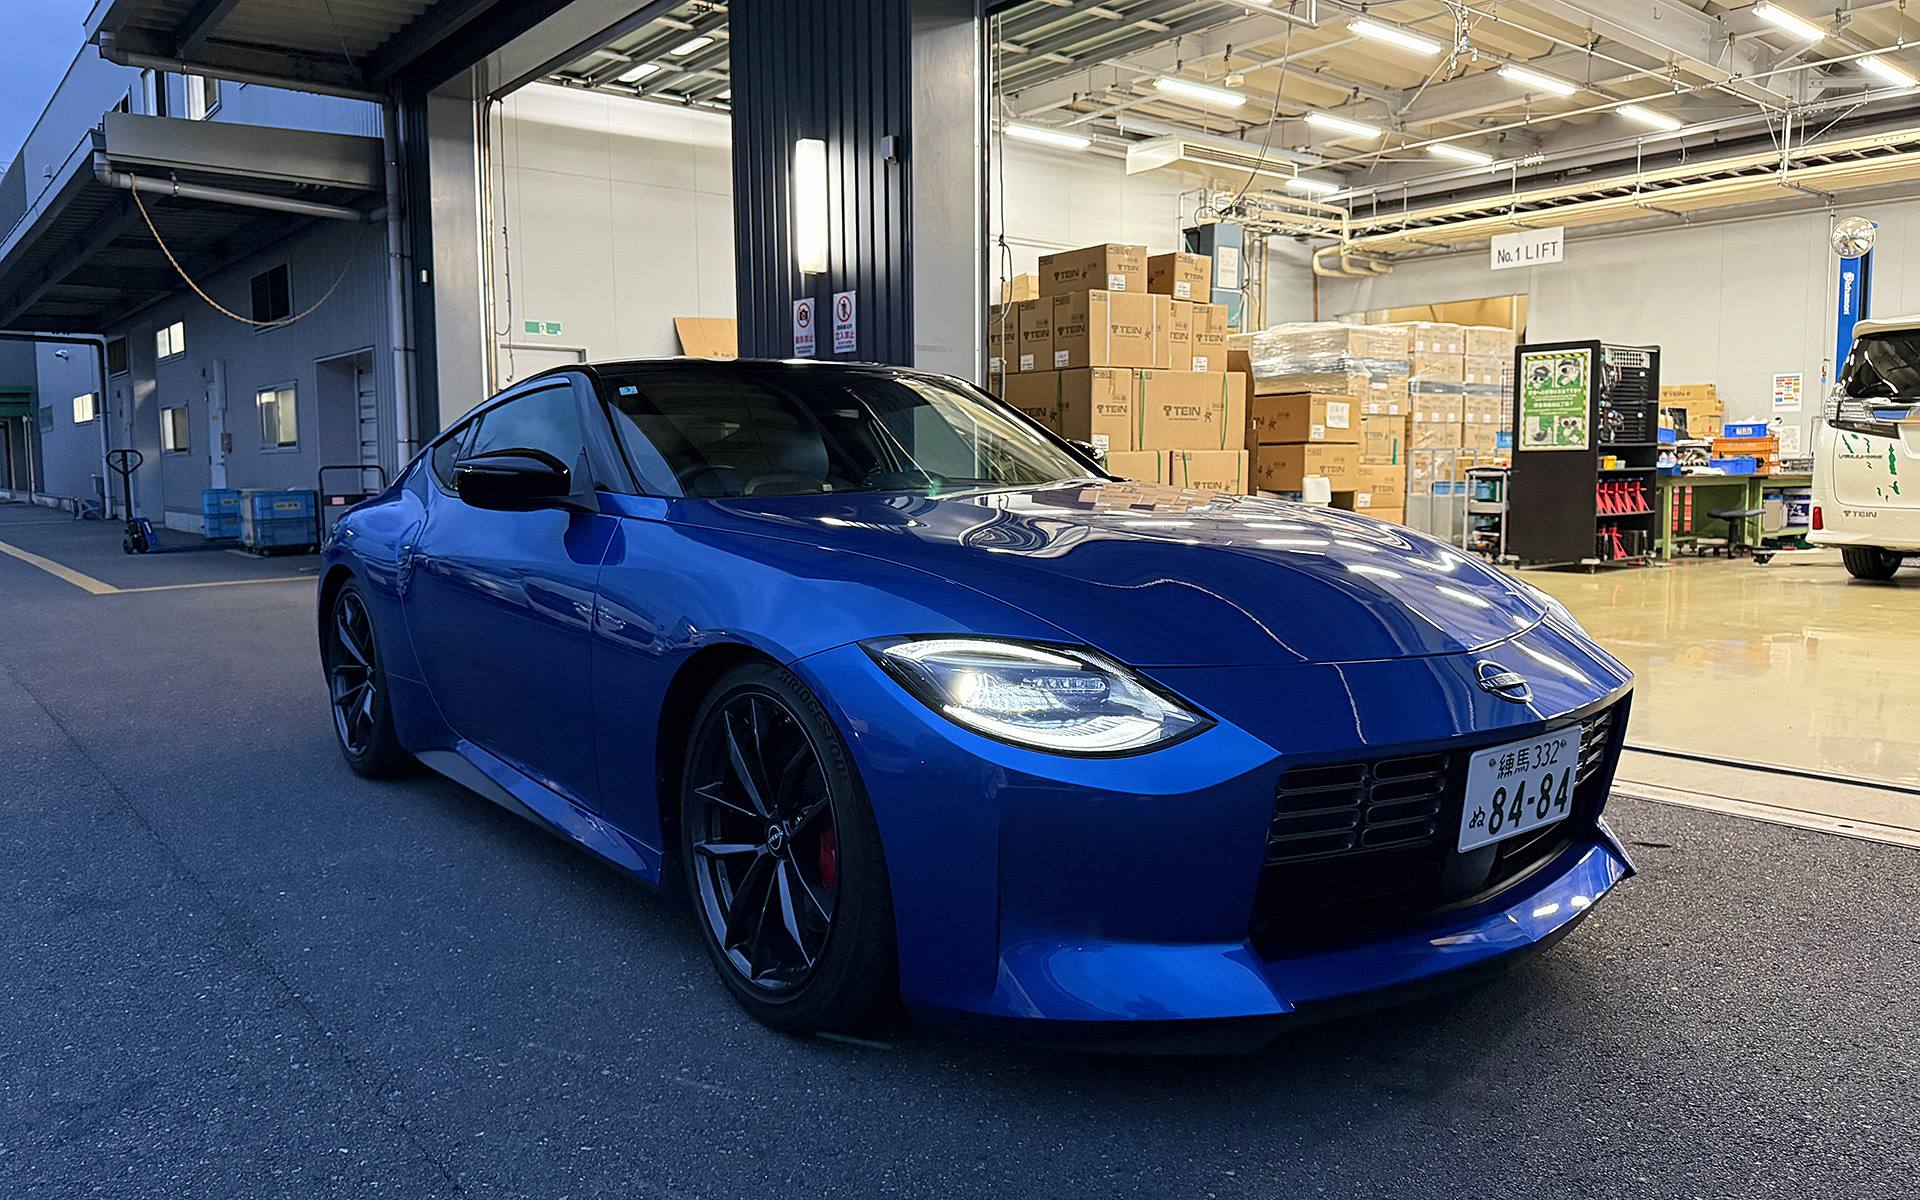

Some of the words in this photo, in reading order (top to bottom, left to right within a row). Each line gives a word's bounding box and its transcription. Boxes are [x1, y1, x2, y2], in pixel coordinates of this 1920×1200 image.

[1525, 241, 1558, 260] LIFT
[1060, 269, 1080, 279] TEIN
[1188, 273, 1204, 281] TEIN
[1031, 329, 1050, 339] TEIN
[1065, 324, 1086, 335] TEIN
[1119, 325, 1142, 335] TEIN
[1204, 334, 1224, 342] TEIN
[1105, 404, 1128, 414] TEIN
[1173, 406, 1201, 417] TEIN
[1369, 431, 1384, 439] TEIN
[1326, 465, 1346, 474] TEIN
[1201, 481, 1222, 490] TEIN
[1377, 485, 1395, 493] TEIN
[1853, 510, 1877, 518] TEIN
[1497, 747, 1530, 779] 練馬
[1531, 739, 1561, 770] 332
[1468, 805, 1486, 830] ぬ
[1488, 766, 1571, 836] 84-84
